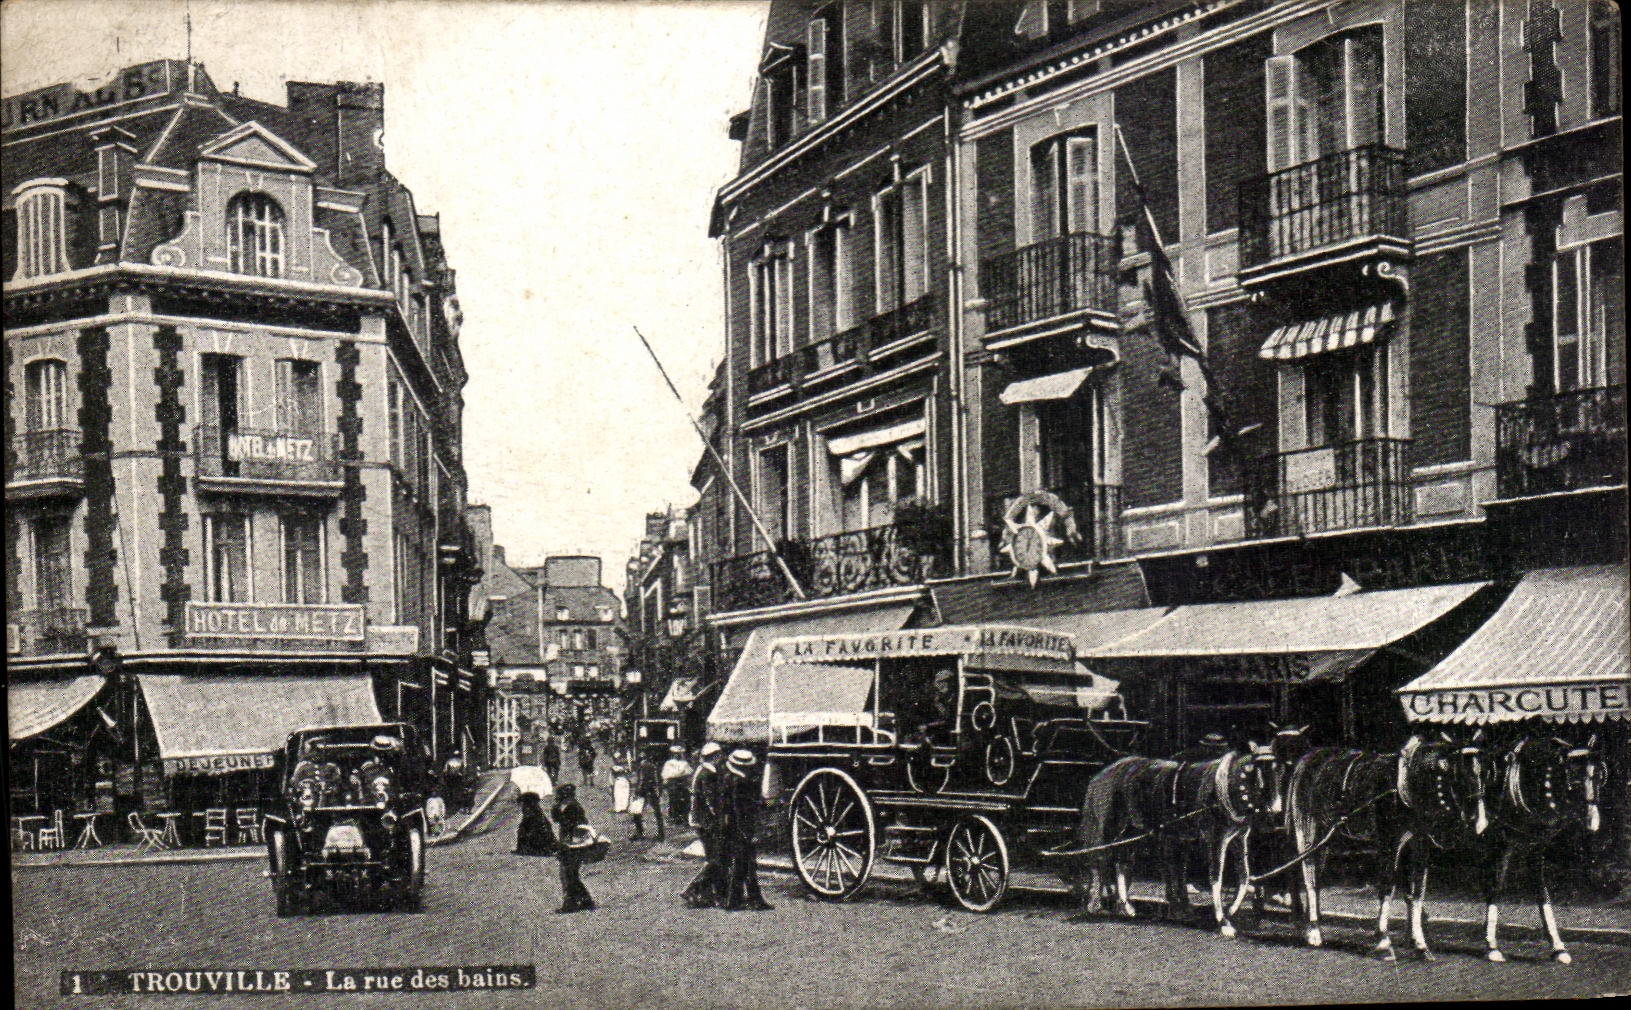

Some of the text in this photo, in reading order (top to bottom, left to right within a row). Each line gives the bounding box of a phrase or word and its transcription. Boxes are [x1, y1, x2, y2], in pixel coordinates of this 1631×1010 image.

[277, 437, 314, 461] METZ
[194, 610, 358, 635] HOTEL de METZ
[794, 634, 934, 656] LA FAVORITE
[980, 630, 1069, 651] LA FAVORITE
[1410, 685, 1631, 716] CHARCUTE
